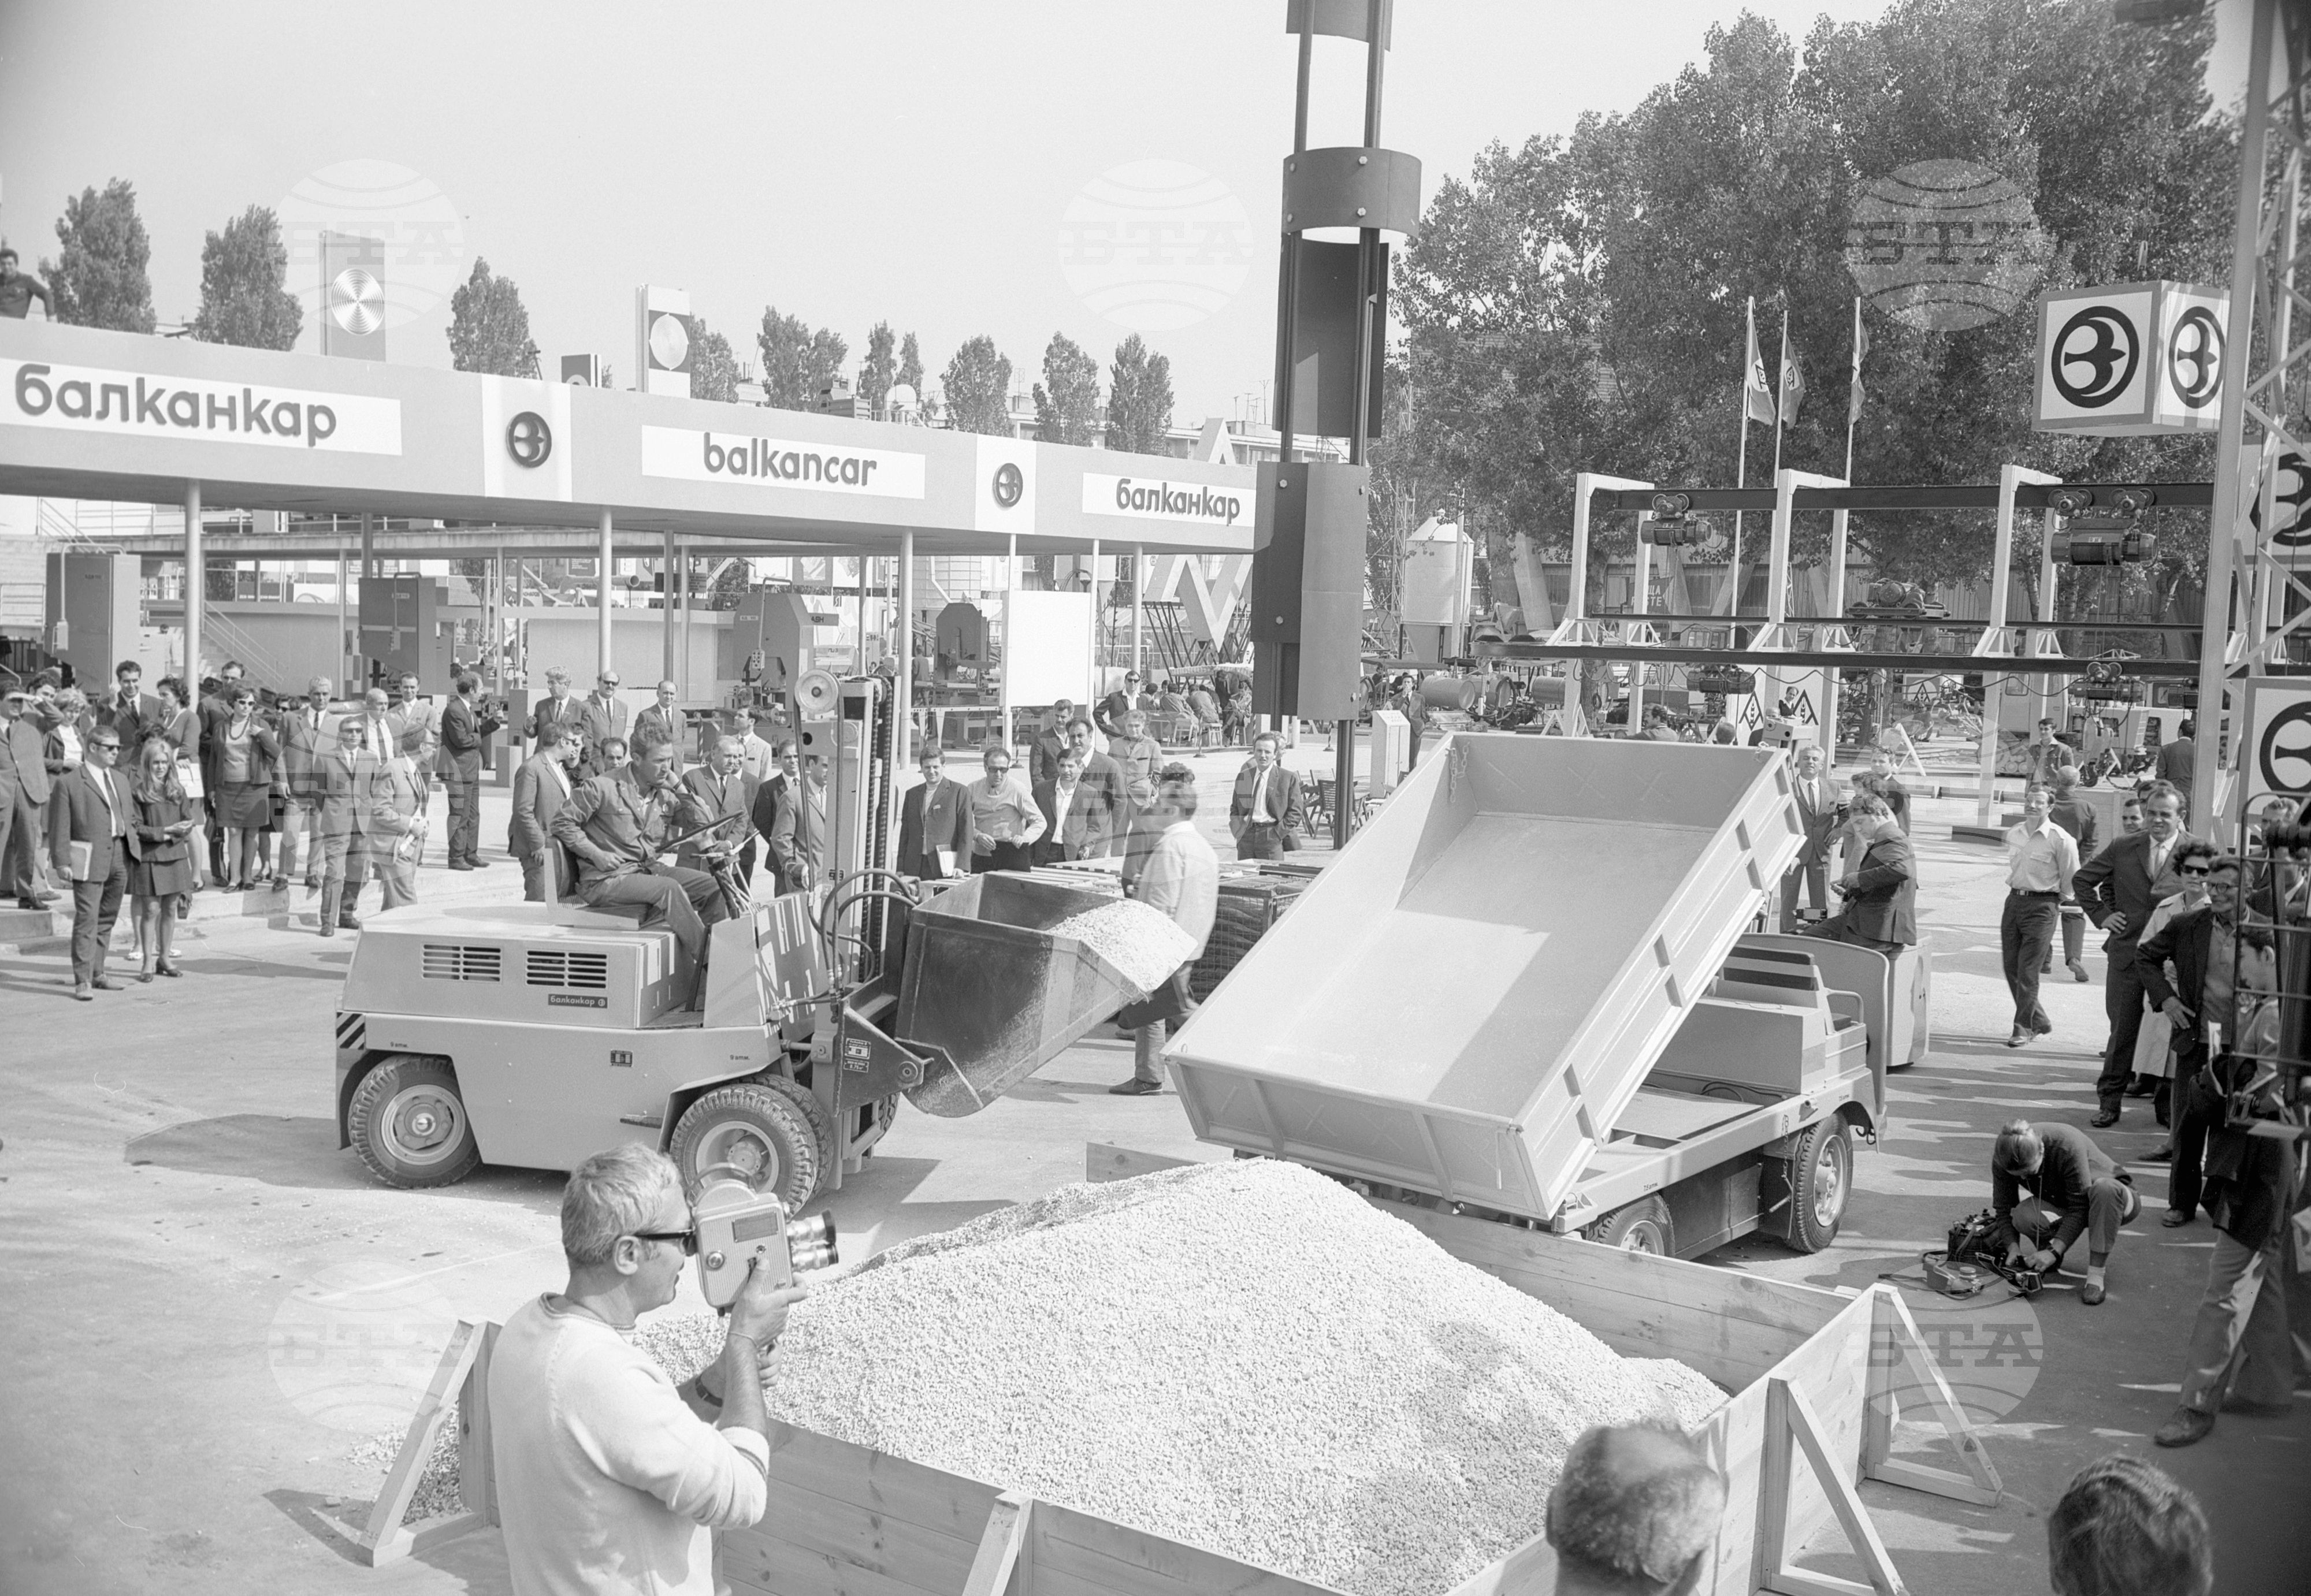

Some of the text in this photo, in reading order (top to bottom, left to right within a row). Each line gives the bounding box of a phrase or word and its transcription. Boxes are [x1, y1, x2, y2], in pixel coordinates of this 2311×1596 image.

[16, 363, 337, 447] балканкар
[703, 432, 877, 486] balkancar
[1116, 478, 1240, 526] балканкар
[550, 995, 595, 1007] балканкар
